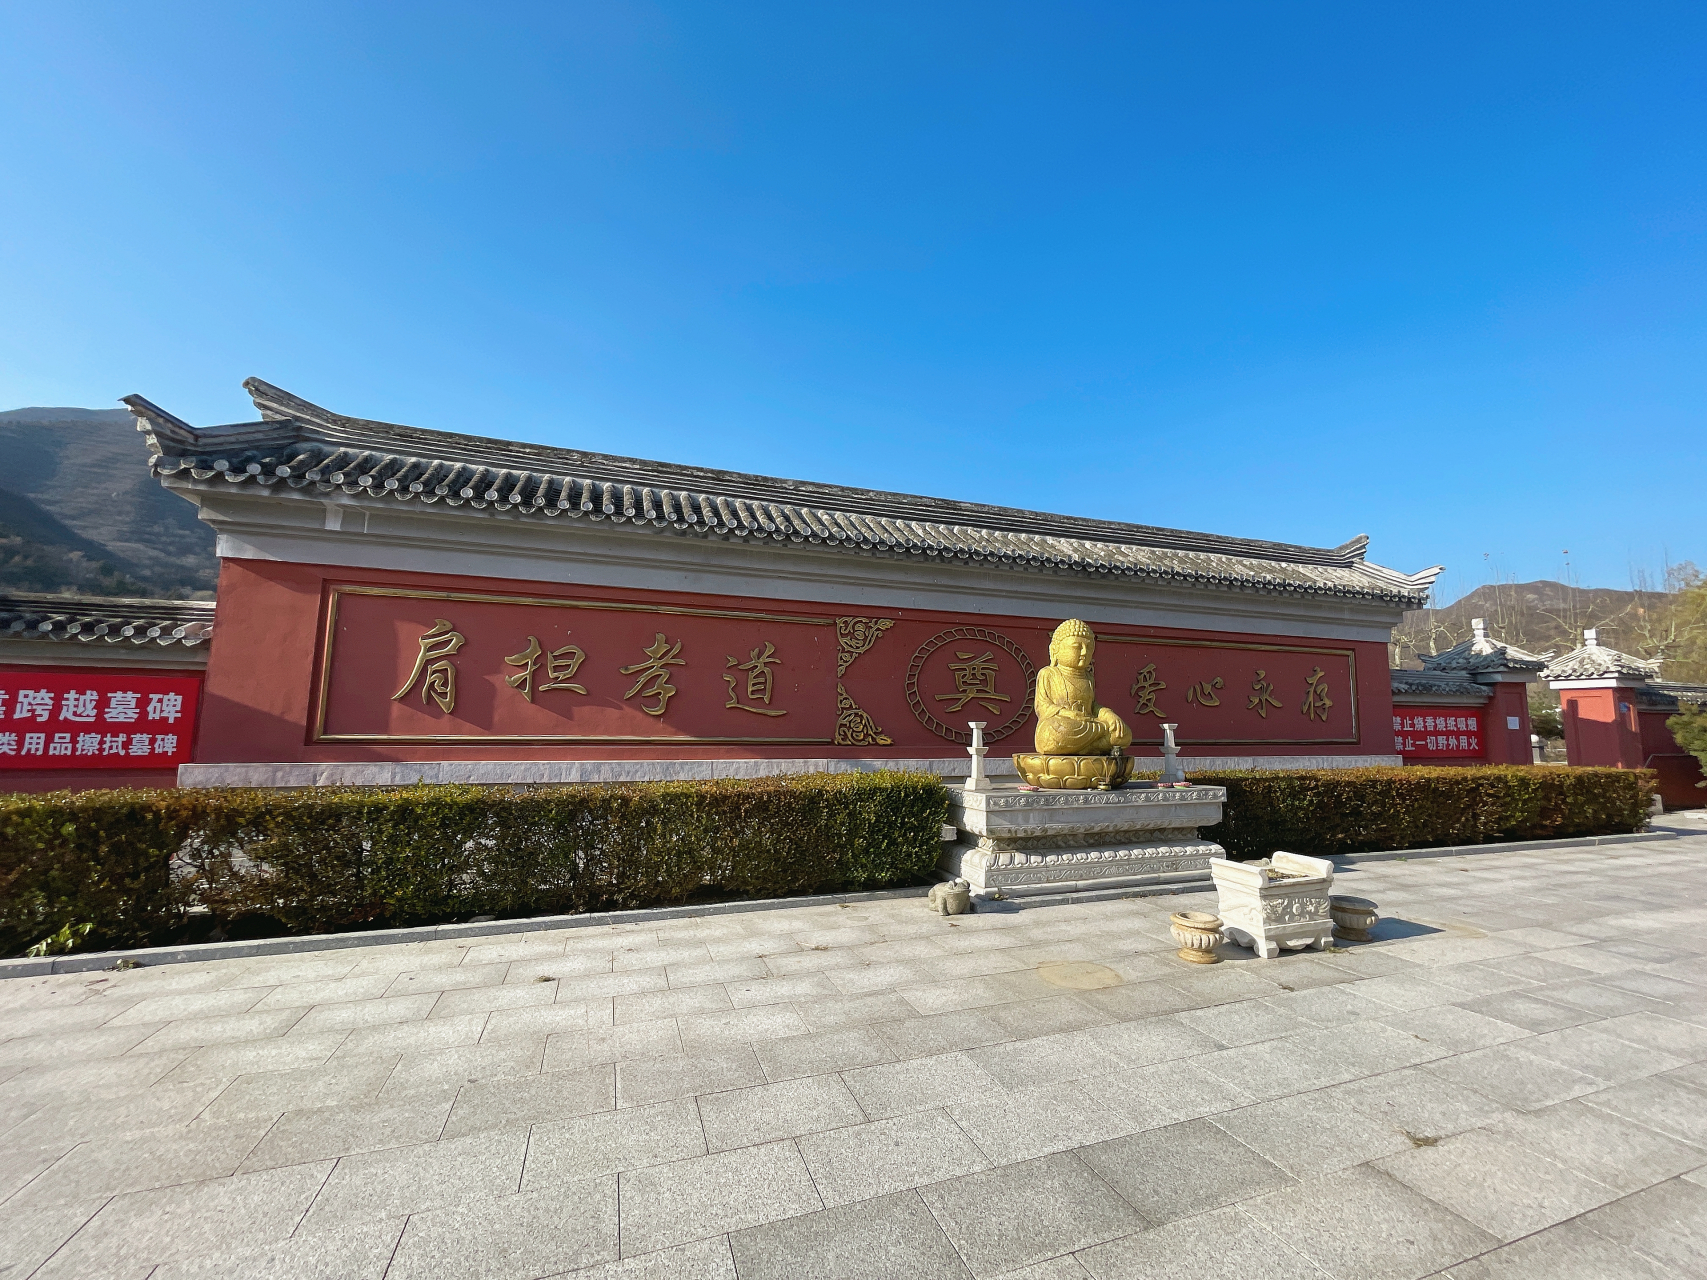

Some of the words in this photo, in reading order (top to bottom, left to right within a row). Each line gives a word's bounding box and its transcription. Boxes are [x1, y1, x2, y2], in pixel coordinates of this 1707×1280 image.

[391, 618, 787, 717] 肩担孝道
[934, 651, 1012, 715] 奠
[0, 689, 182, 723] 跨越墓碑
[1130, 663, 1333, 722] 爱心永存
[1393, 716, 1478, 731] 禁止烧香烧纸吸烟
[0, 732, 178, 756] 类用品擦拭墓碑
[1394, 735, 1479, 751] 禁止一切野外用火
